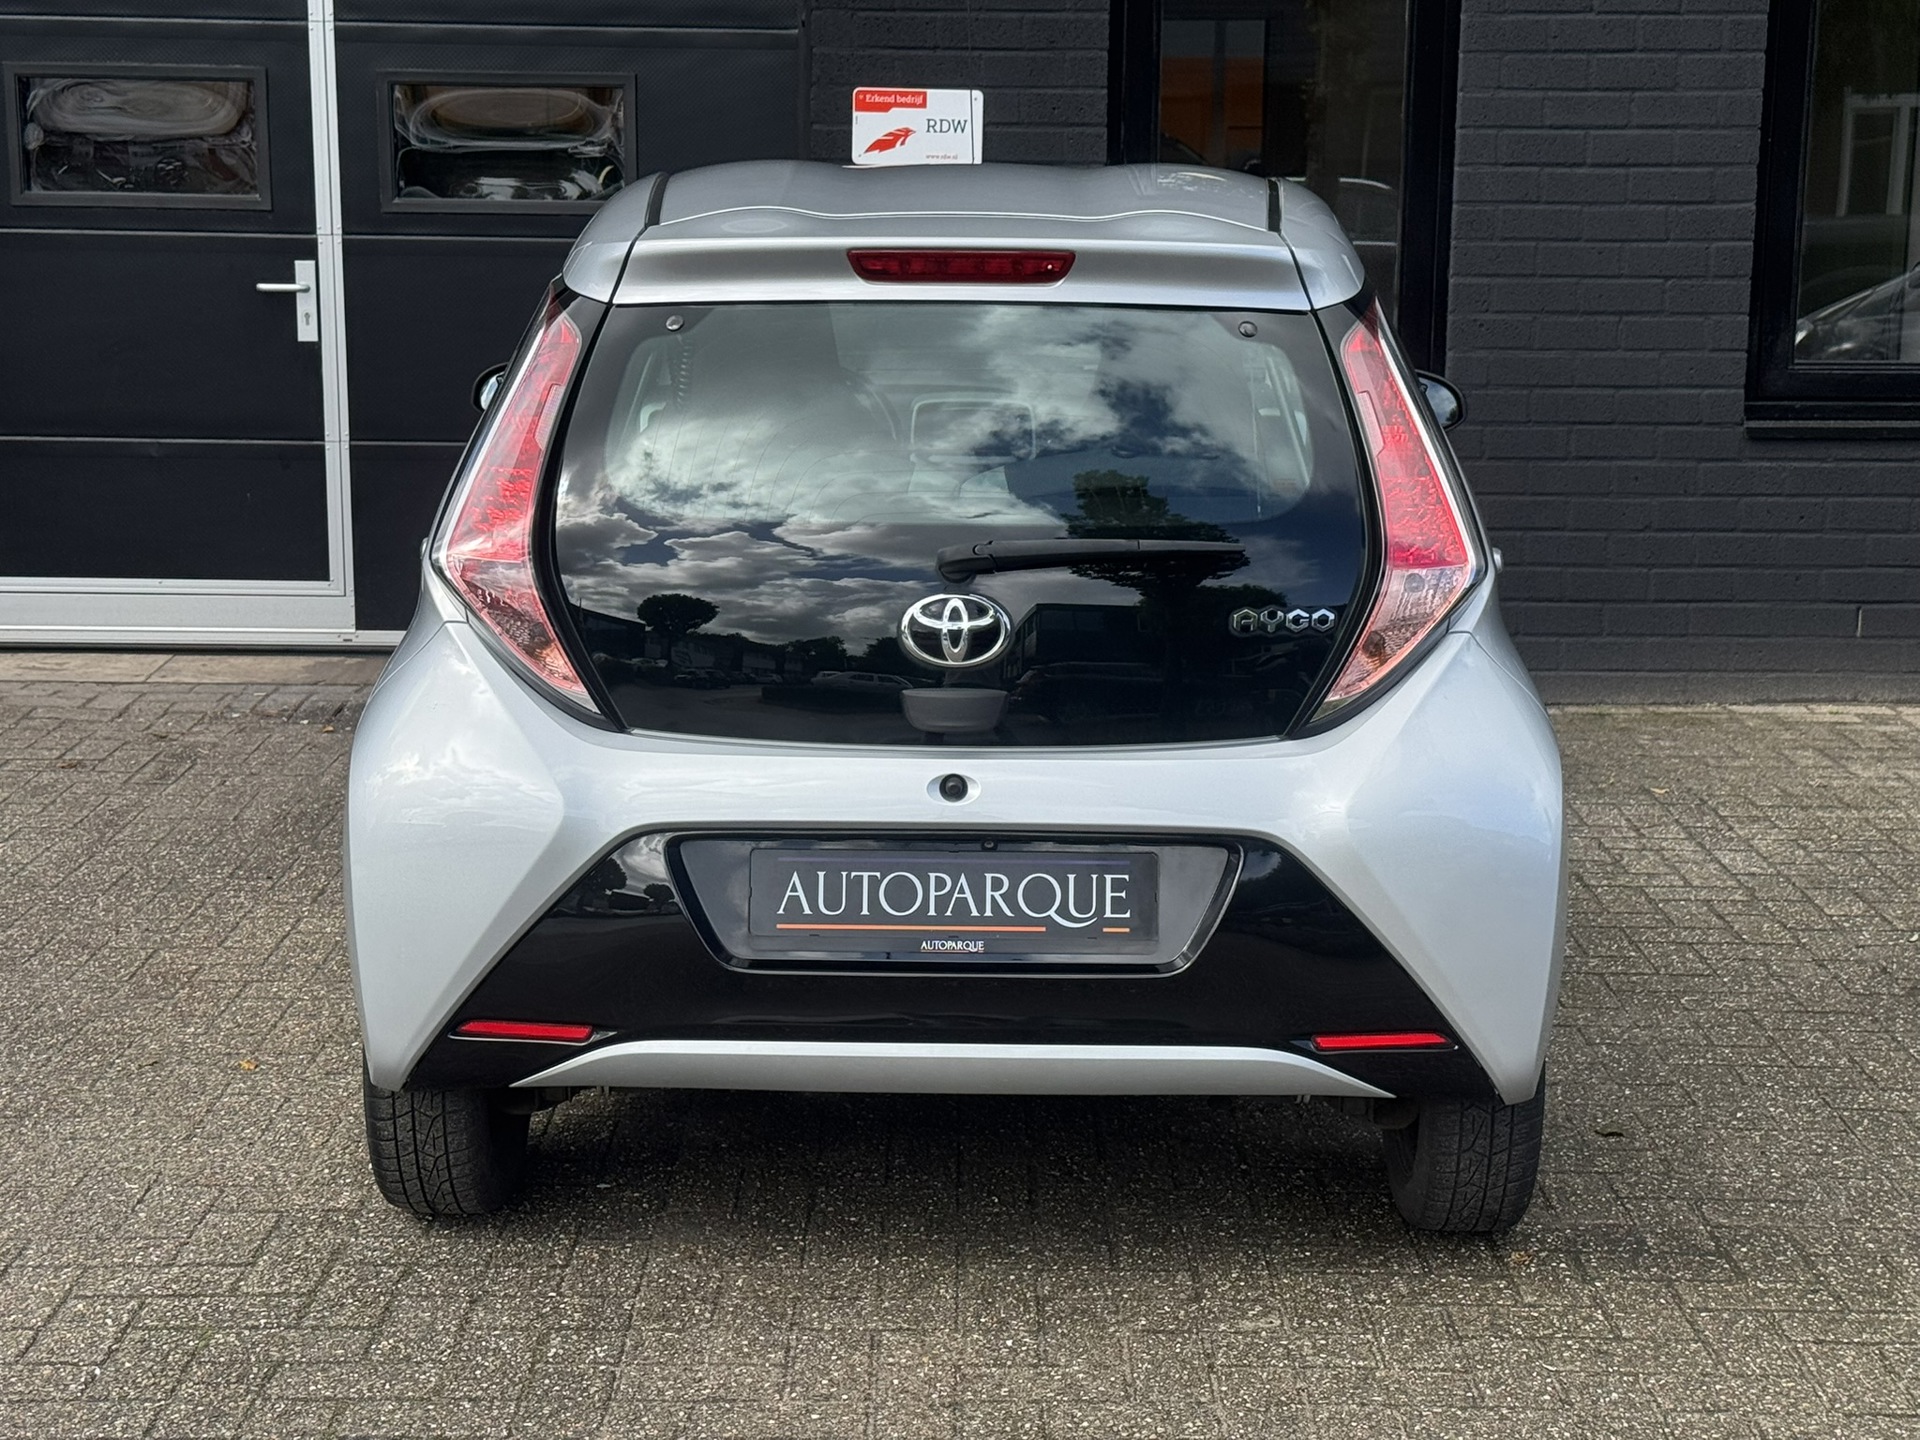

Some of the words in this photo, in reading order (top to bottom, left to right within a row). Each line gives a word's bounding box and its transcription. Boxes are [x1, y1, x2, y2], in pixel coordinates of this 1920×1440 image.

[865, 94, 895, 103] Erkend
[897, 95, 923, 105] bedrijf
[926, 119, 968, 133] RDW
[1233, 608, 1335, 632] AYGO
[776, 870, 1130, 928] AUTOPARQUE
[920, 940, 985, 951] AUTOPARQUE
